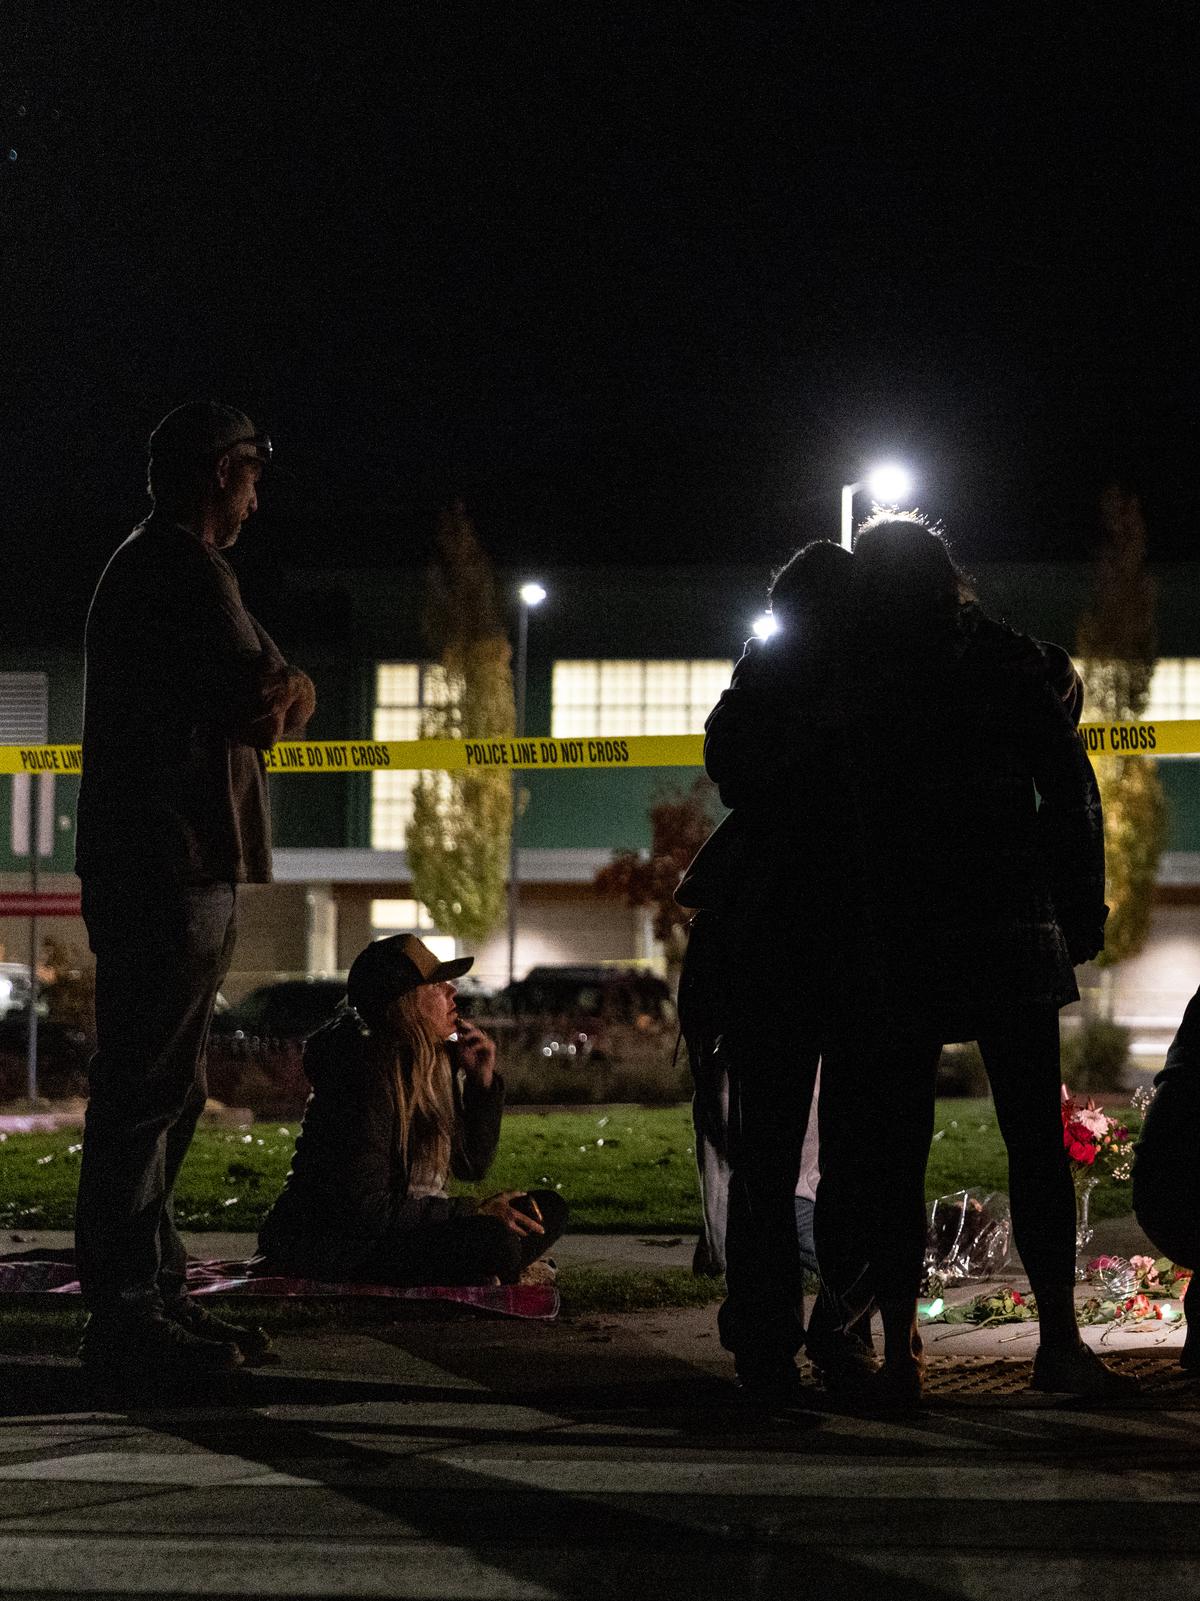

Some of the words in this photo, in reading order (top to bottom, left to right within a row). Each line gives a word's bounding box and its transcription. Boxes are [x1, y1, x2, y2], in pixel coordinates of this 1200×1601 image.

[1110, 725, 1156, 750] CROSS
[20, 750, 60, 769] POLICE
[278, 747, 304, 767] LINE
[307, 747, 324, 767] DO
[325, 746, 349, 767] NOT
[351, 745, 390, 766] CROSS
[465, 743, 508, 765] POLICE
[510, 742, 538, 764] LINE
[541, 742, 558, 763] DO
[560, 741, 584, 763] NOT
[588, 740, 629, 762] CROSS
